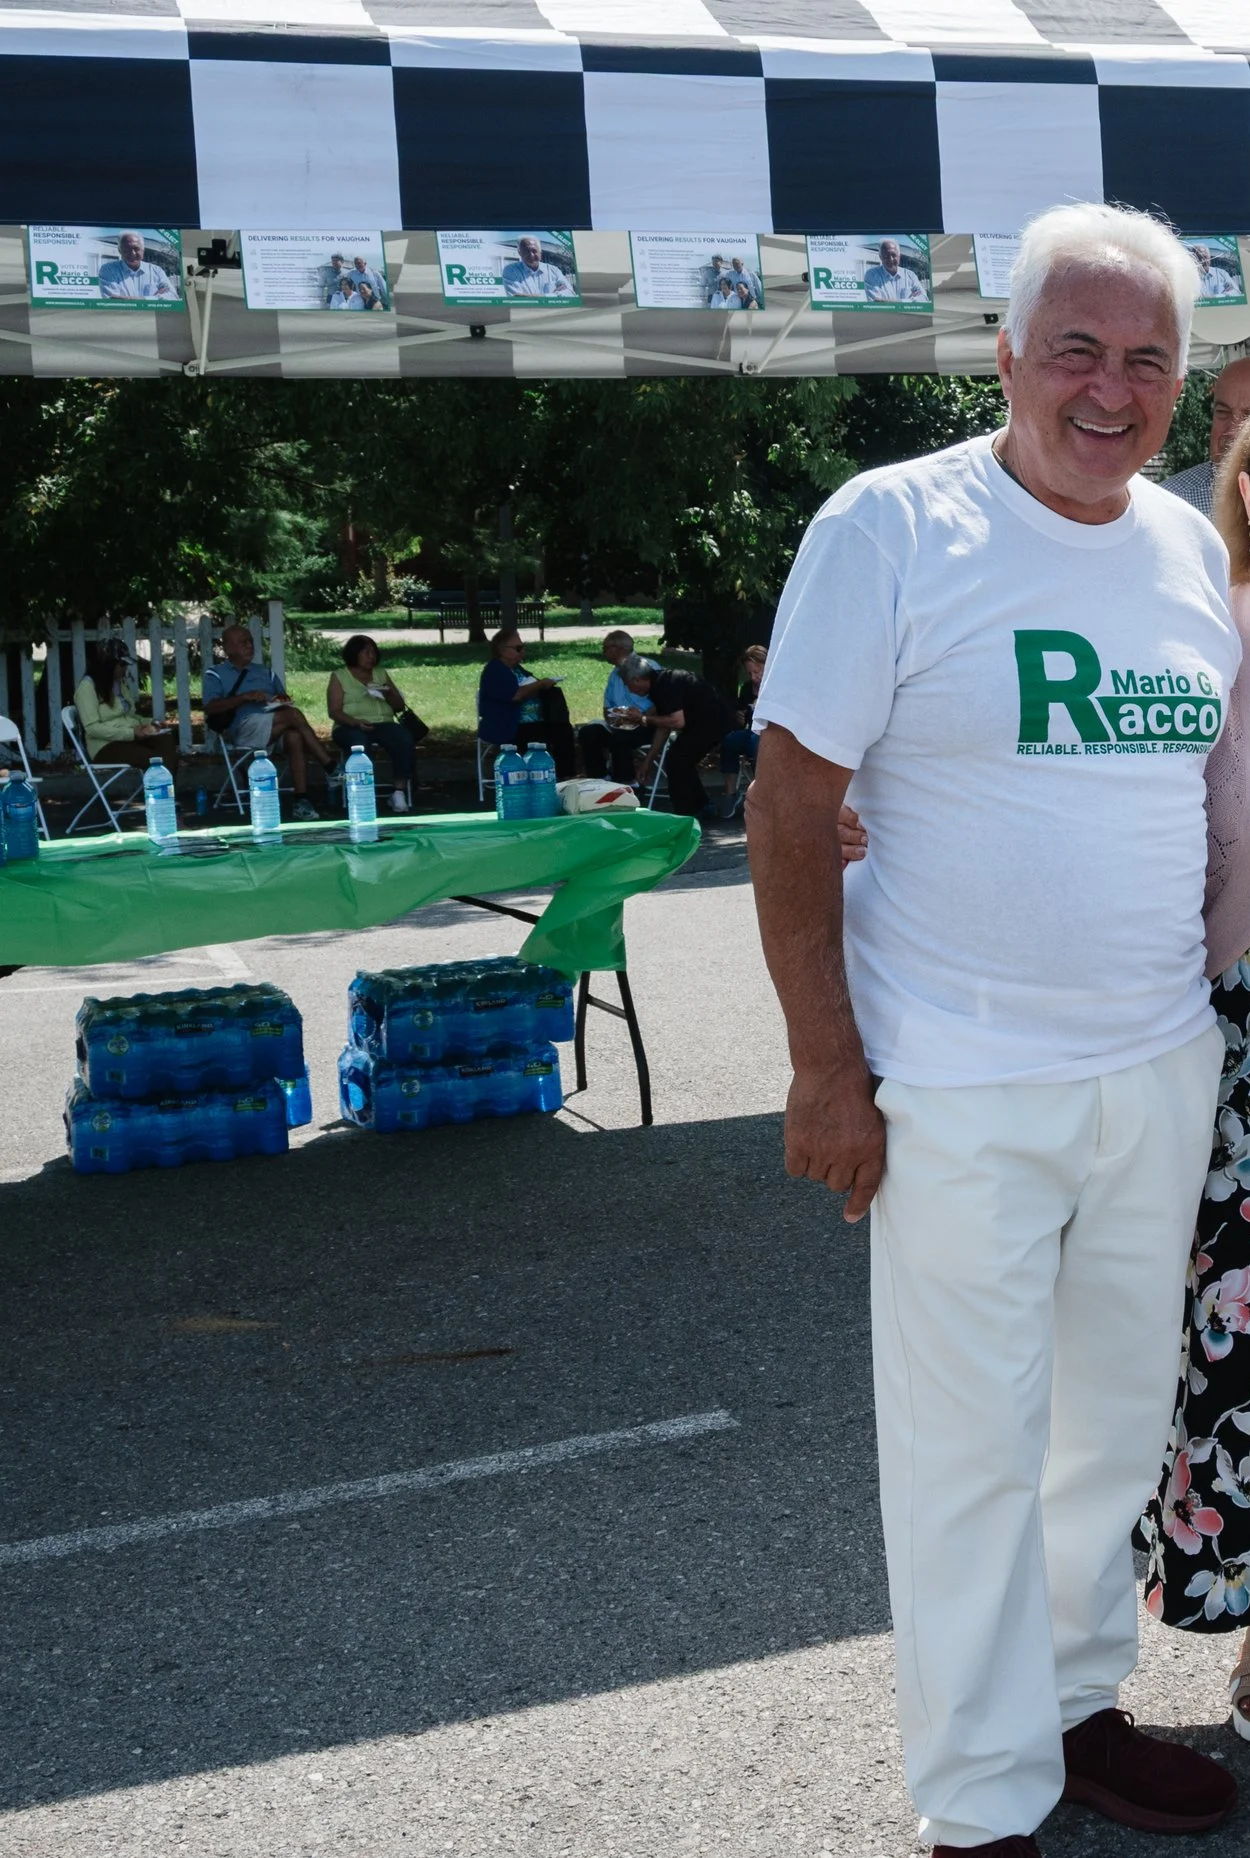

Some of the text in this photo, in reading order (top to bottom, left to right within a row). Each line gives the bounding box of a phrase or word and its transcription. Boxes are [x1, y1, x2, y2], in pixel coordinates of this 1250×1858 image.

[290, 235, 321, 243] RESULTS
[321, 235, 336, 243] FOR
[337, 235, 371, 243] VAUGHAN
[674, 236, 702, 244] RESULTS
[1110, 668, 1219, 697] Mario G.
[1016, 743, 1082, 755] RELIABLE.
[1084, 743, 1160, 755] RESPONSIBLE.
